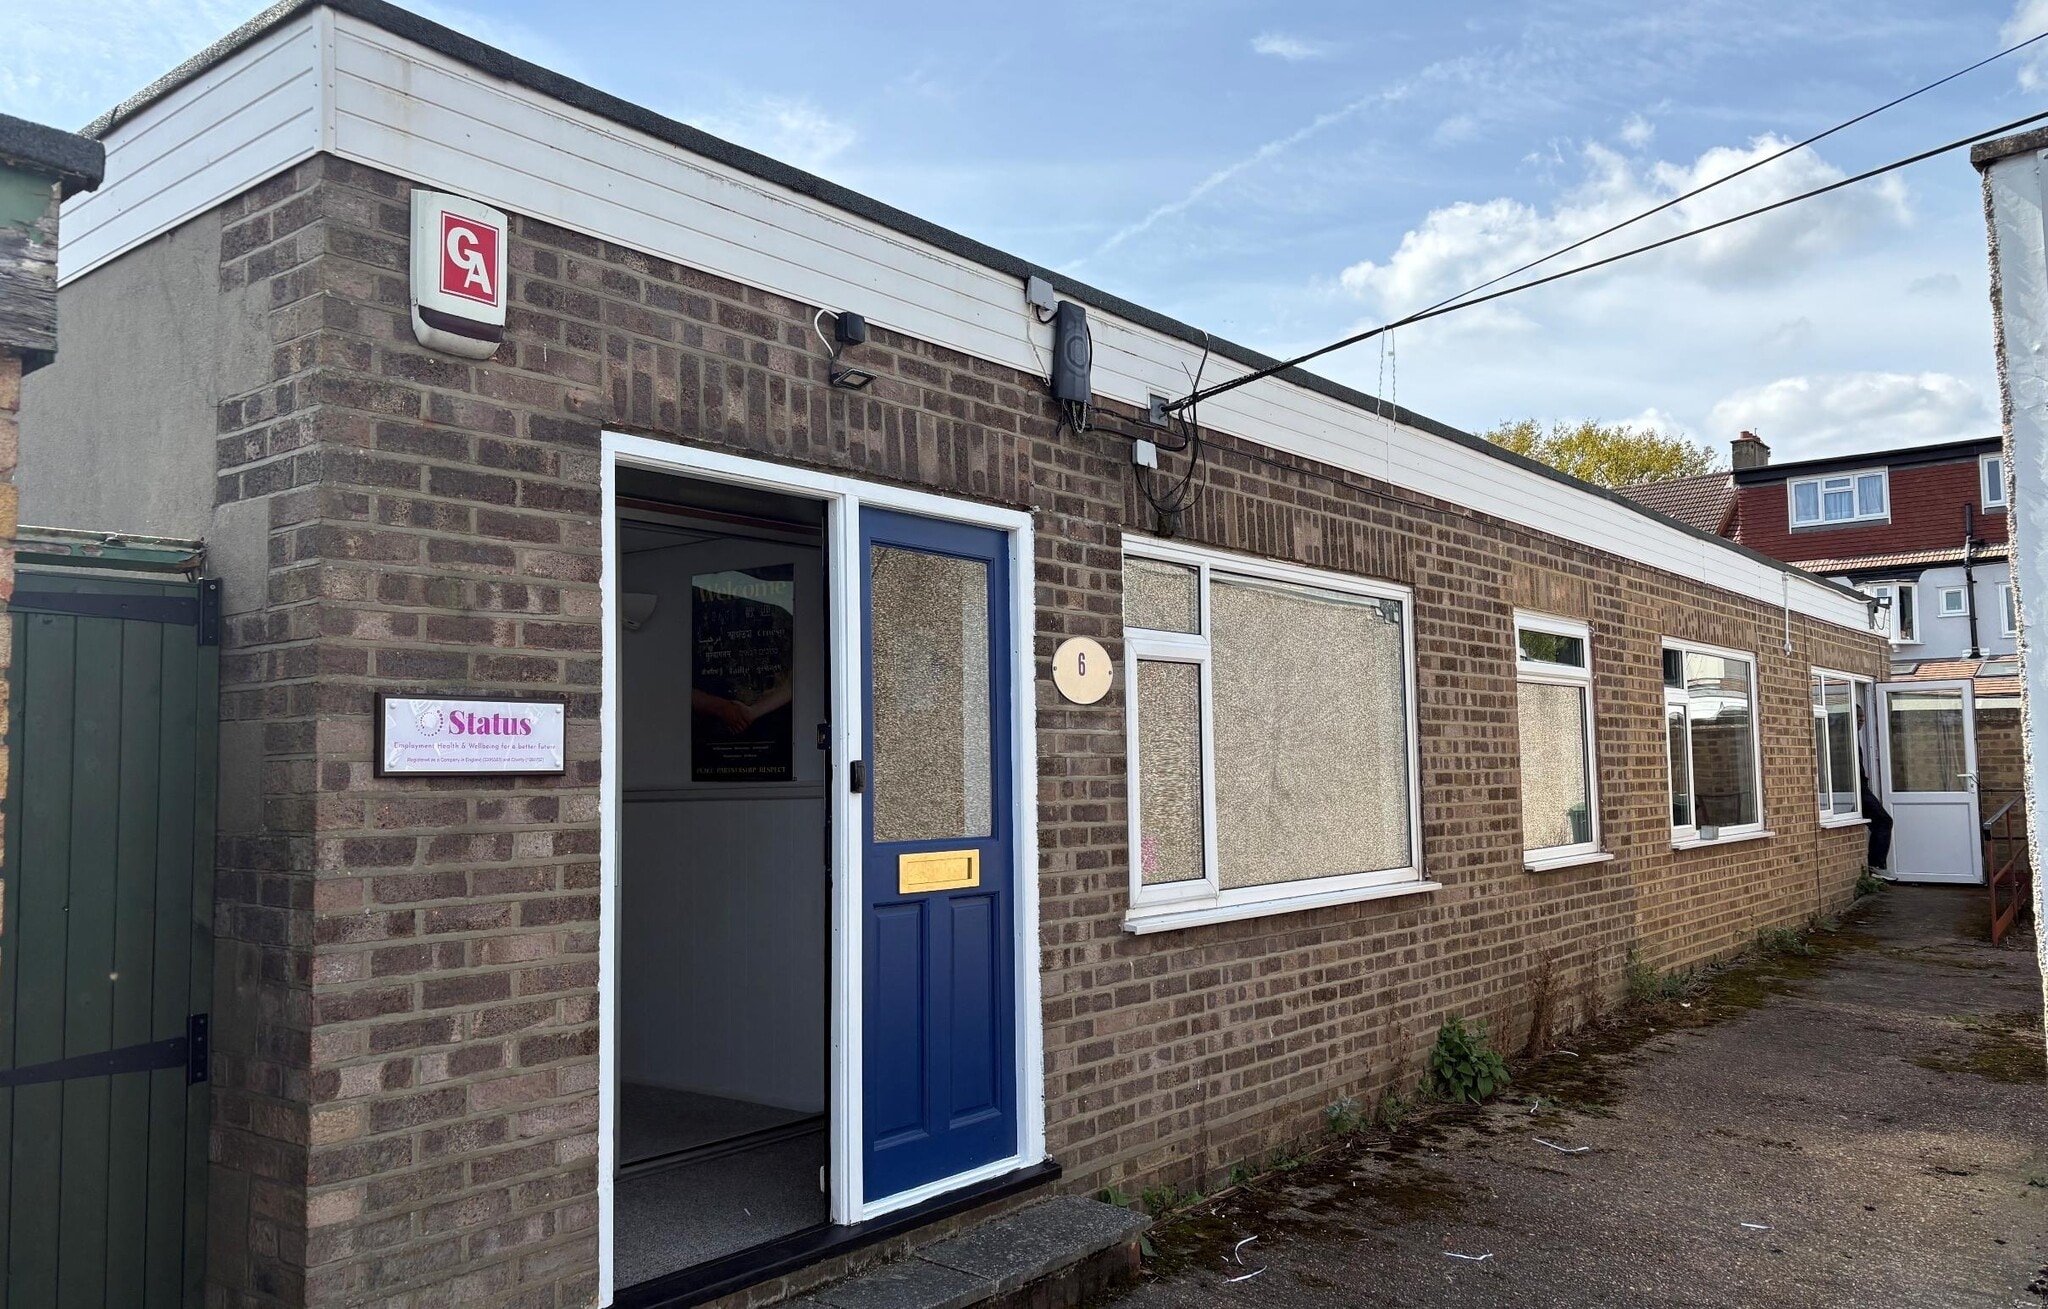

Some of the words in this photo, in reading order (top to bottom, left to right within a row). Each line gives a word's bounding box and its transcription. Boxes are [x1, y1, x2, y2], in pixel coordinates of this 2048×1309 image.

[699, 581, 786, 603] Welcome
[1078, 652, 1086, 677] 6
[448, 709, 532, 737] Status
[393, 741, 435, 750] Employment
[437, 741, 459, 749] Health
[468, 742, 500, 751] Wellbeing
[518, 742, 536, 750] better
